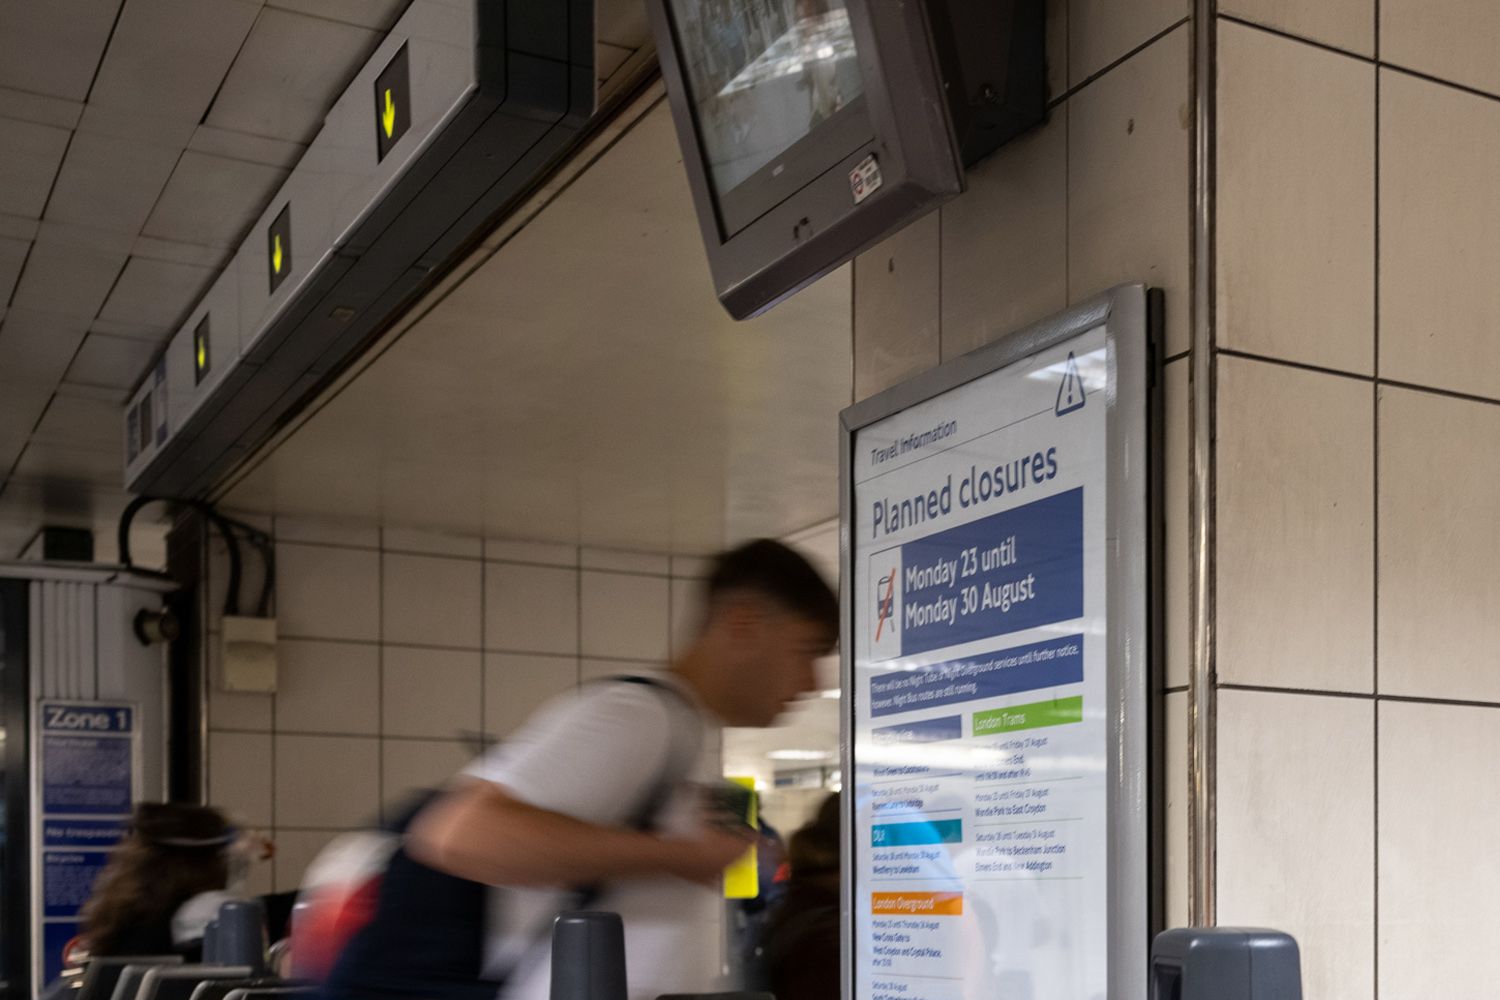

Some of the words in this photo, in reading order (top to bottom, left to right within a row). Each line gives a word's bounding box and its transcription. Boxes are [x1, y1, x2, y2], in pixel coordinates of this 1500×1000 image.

[870, 441, 899, 466] Travel
[900, 420, 957, 455] Information
[872, 475, 952, 539] Planned
[959, 445, 1058, 509] closures
[905, 556, 957, 594] Monday
[961, 549, 978, 578] 23
[981, 536, 1017, 572] until
[905, 596, 957, 630] Monday
[961, 588, 978, 616] 30
[981, 574, 1036, 614] August
[994, 654, 1017, 670] services
[1018, 651, 1031, 666] until
[1033, 646, 1055, 663] further
[48, 707, 110, 729] Zone
[116, 711, 126, 729] 1
[975, 715, 1001, 731] London
[1002, 710, 1025, 727] Trams
[873, 897, 896, 909] London
[897, 897, 933, 912] Overground
